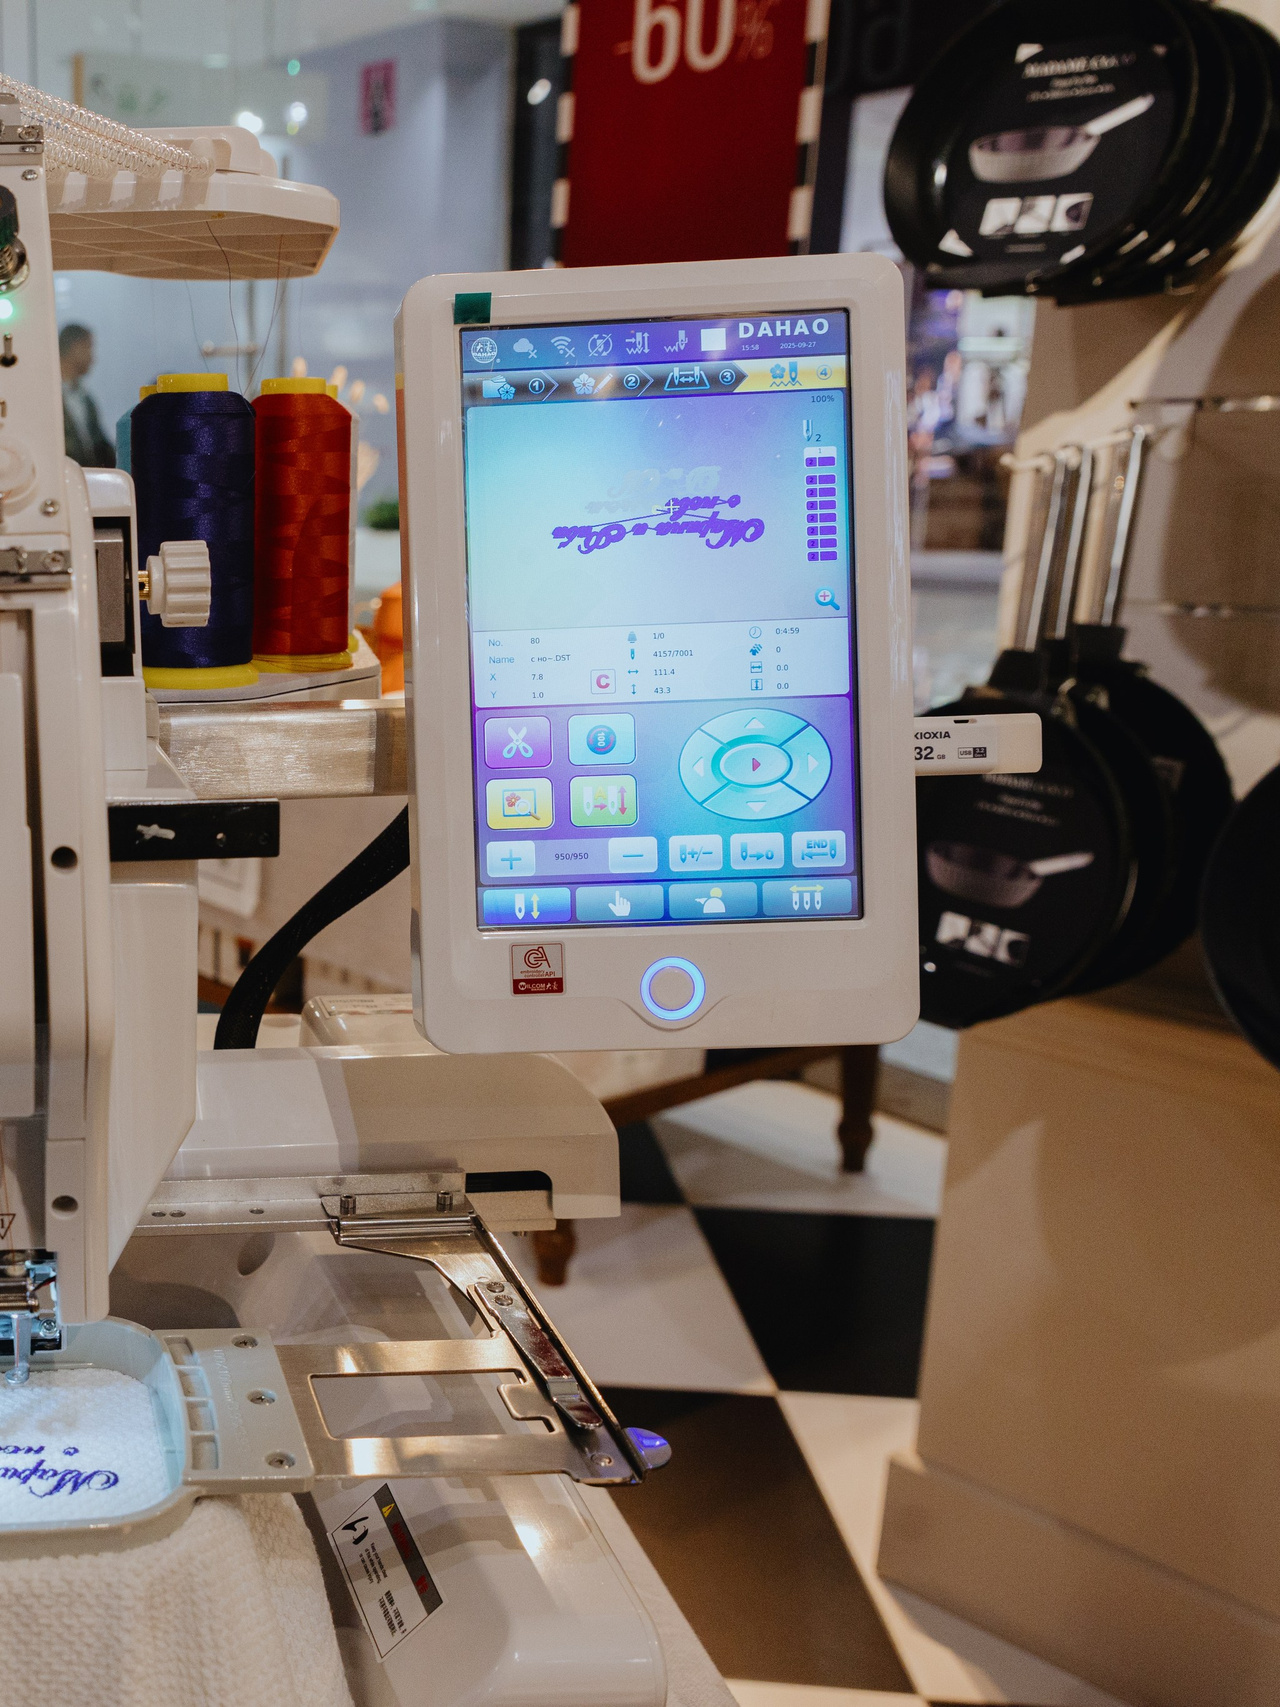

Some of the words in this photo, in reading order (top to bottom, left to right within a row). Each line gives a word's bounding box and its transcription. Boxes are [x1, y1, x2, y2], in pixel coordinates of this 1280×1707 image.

[738, 318, 829, 339] DAHAO
[779, 341, 816, 350] 2025-09-27
[811, 395, 835, 403] 100%
[815, 434, 822, 442] 2
[776, 627, 800, 635] 0:4:59
[488, 639, 503, 647] No.
[653, 650, 693, 658] 4157/7001
[489, 656, 515, 664] Name
[596, 674, 610, 689] C
[490, 691, 497, 699] Y
[597, 732, 606, 747] 100
[914, 746, 934, 760] 32
[806, 839, 828, 849] END
[554, 852, 589, 861] 950/950
